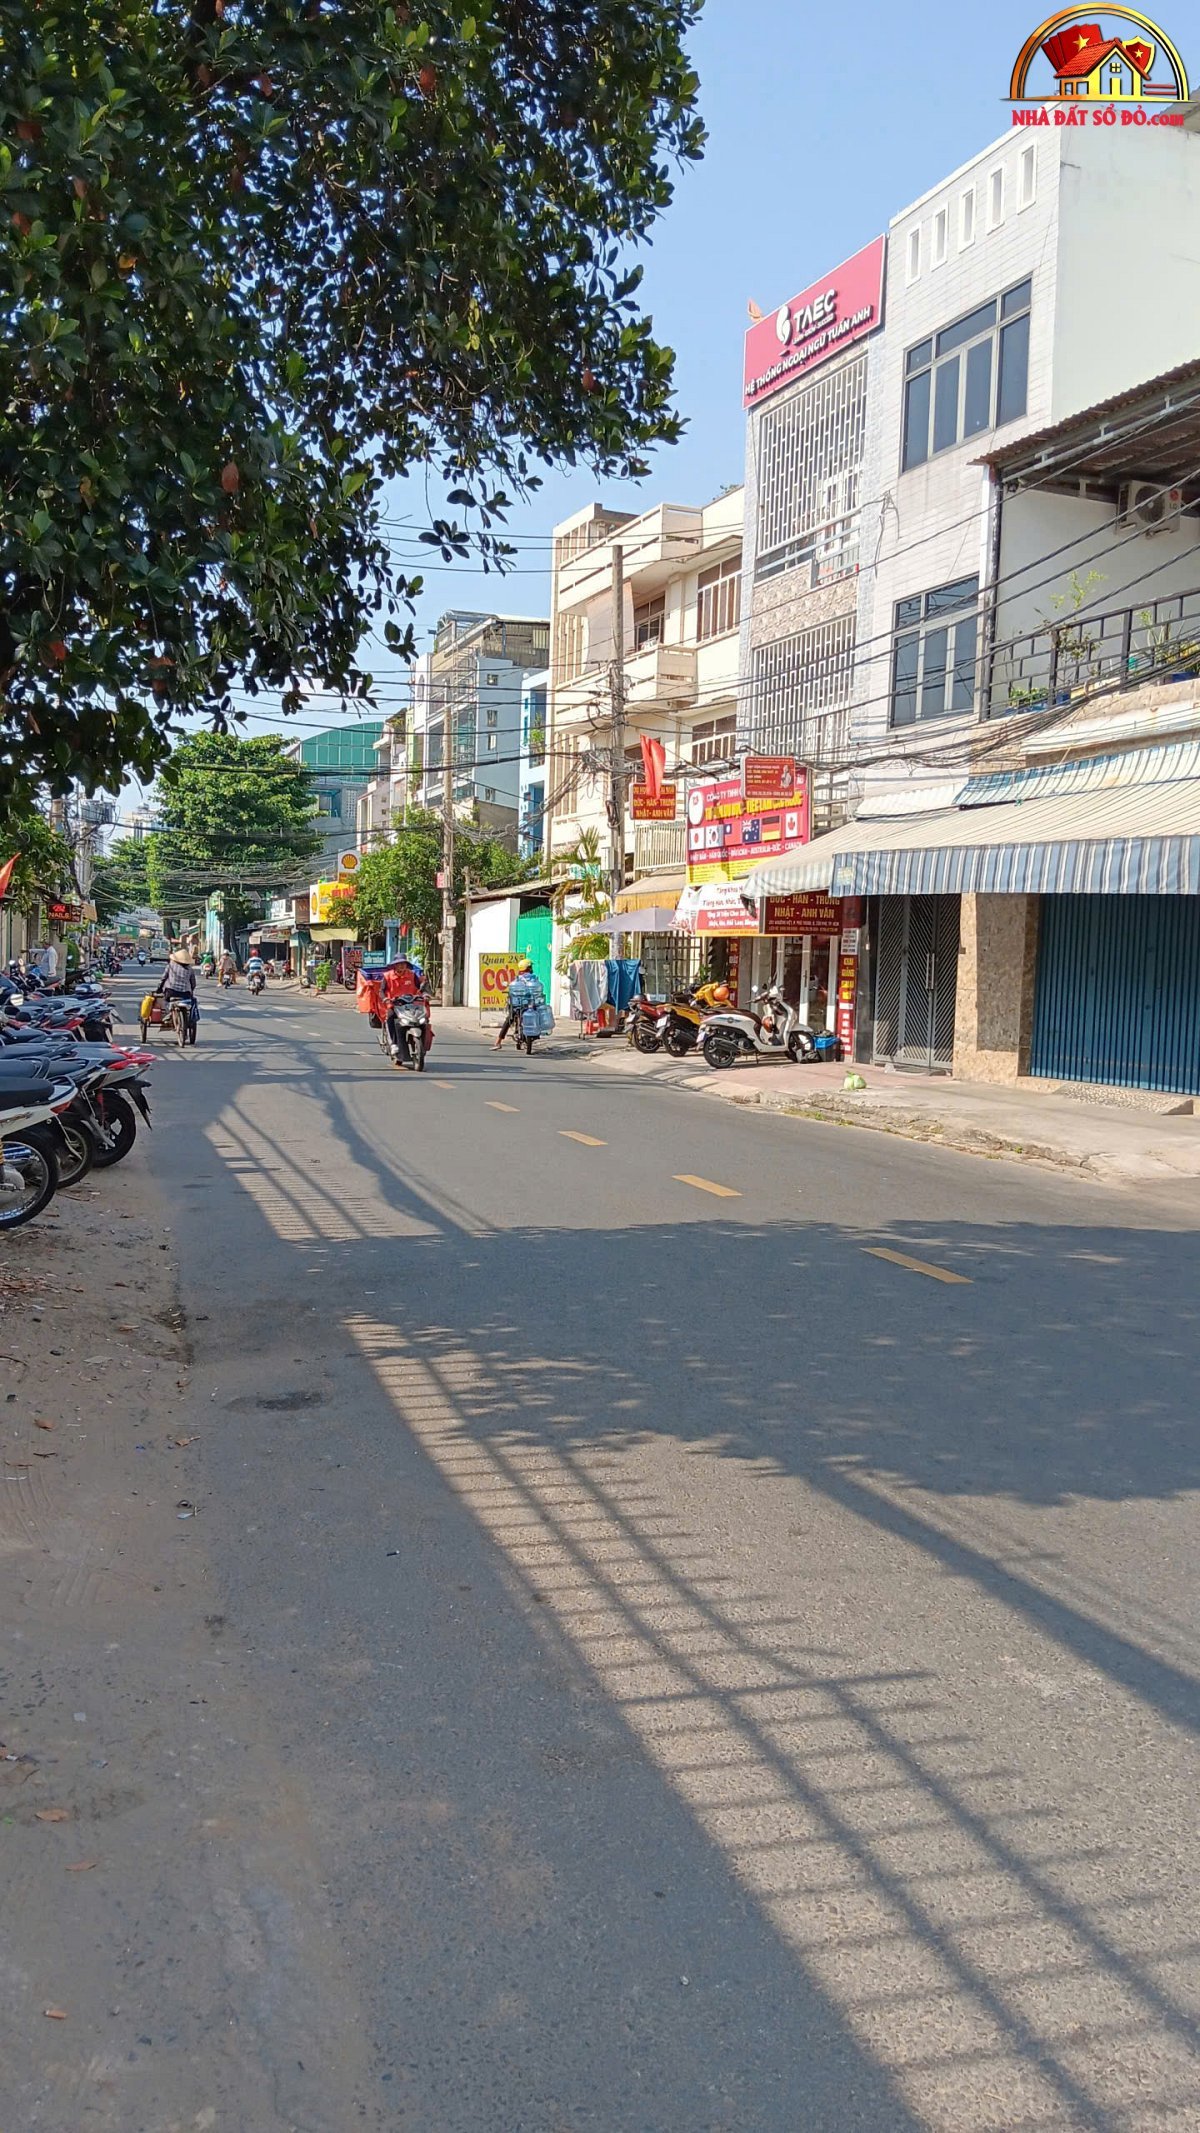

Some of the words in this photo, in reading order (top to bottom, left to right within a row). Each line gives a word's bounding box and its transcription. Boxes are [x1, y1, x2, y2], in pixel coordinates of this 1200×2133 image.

[745, 379, 757, 395] HỆ
[756, 364, 783, 389] THỐNG
[782, 347, 808, 371] NGOẠI
[808, 332, 828, 356] NGỮ
[827, 316, 850, 342] TUẤN
[851, 304, 872, 328] ANH
[774, 905, 795, 919] NHẬT
[801, 908, 818, 918] ANH
[819, 906, 835, 919] VĂN
